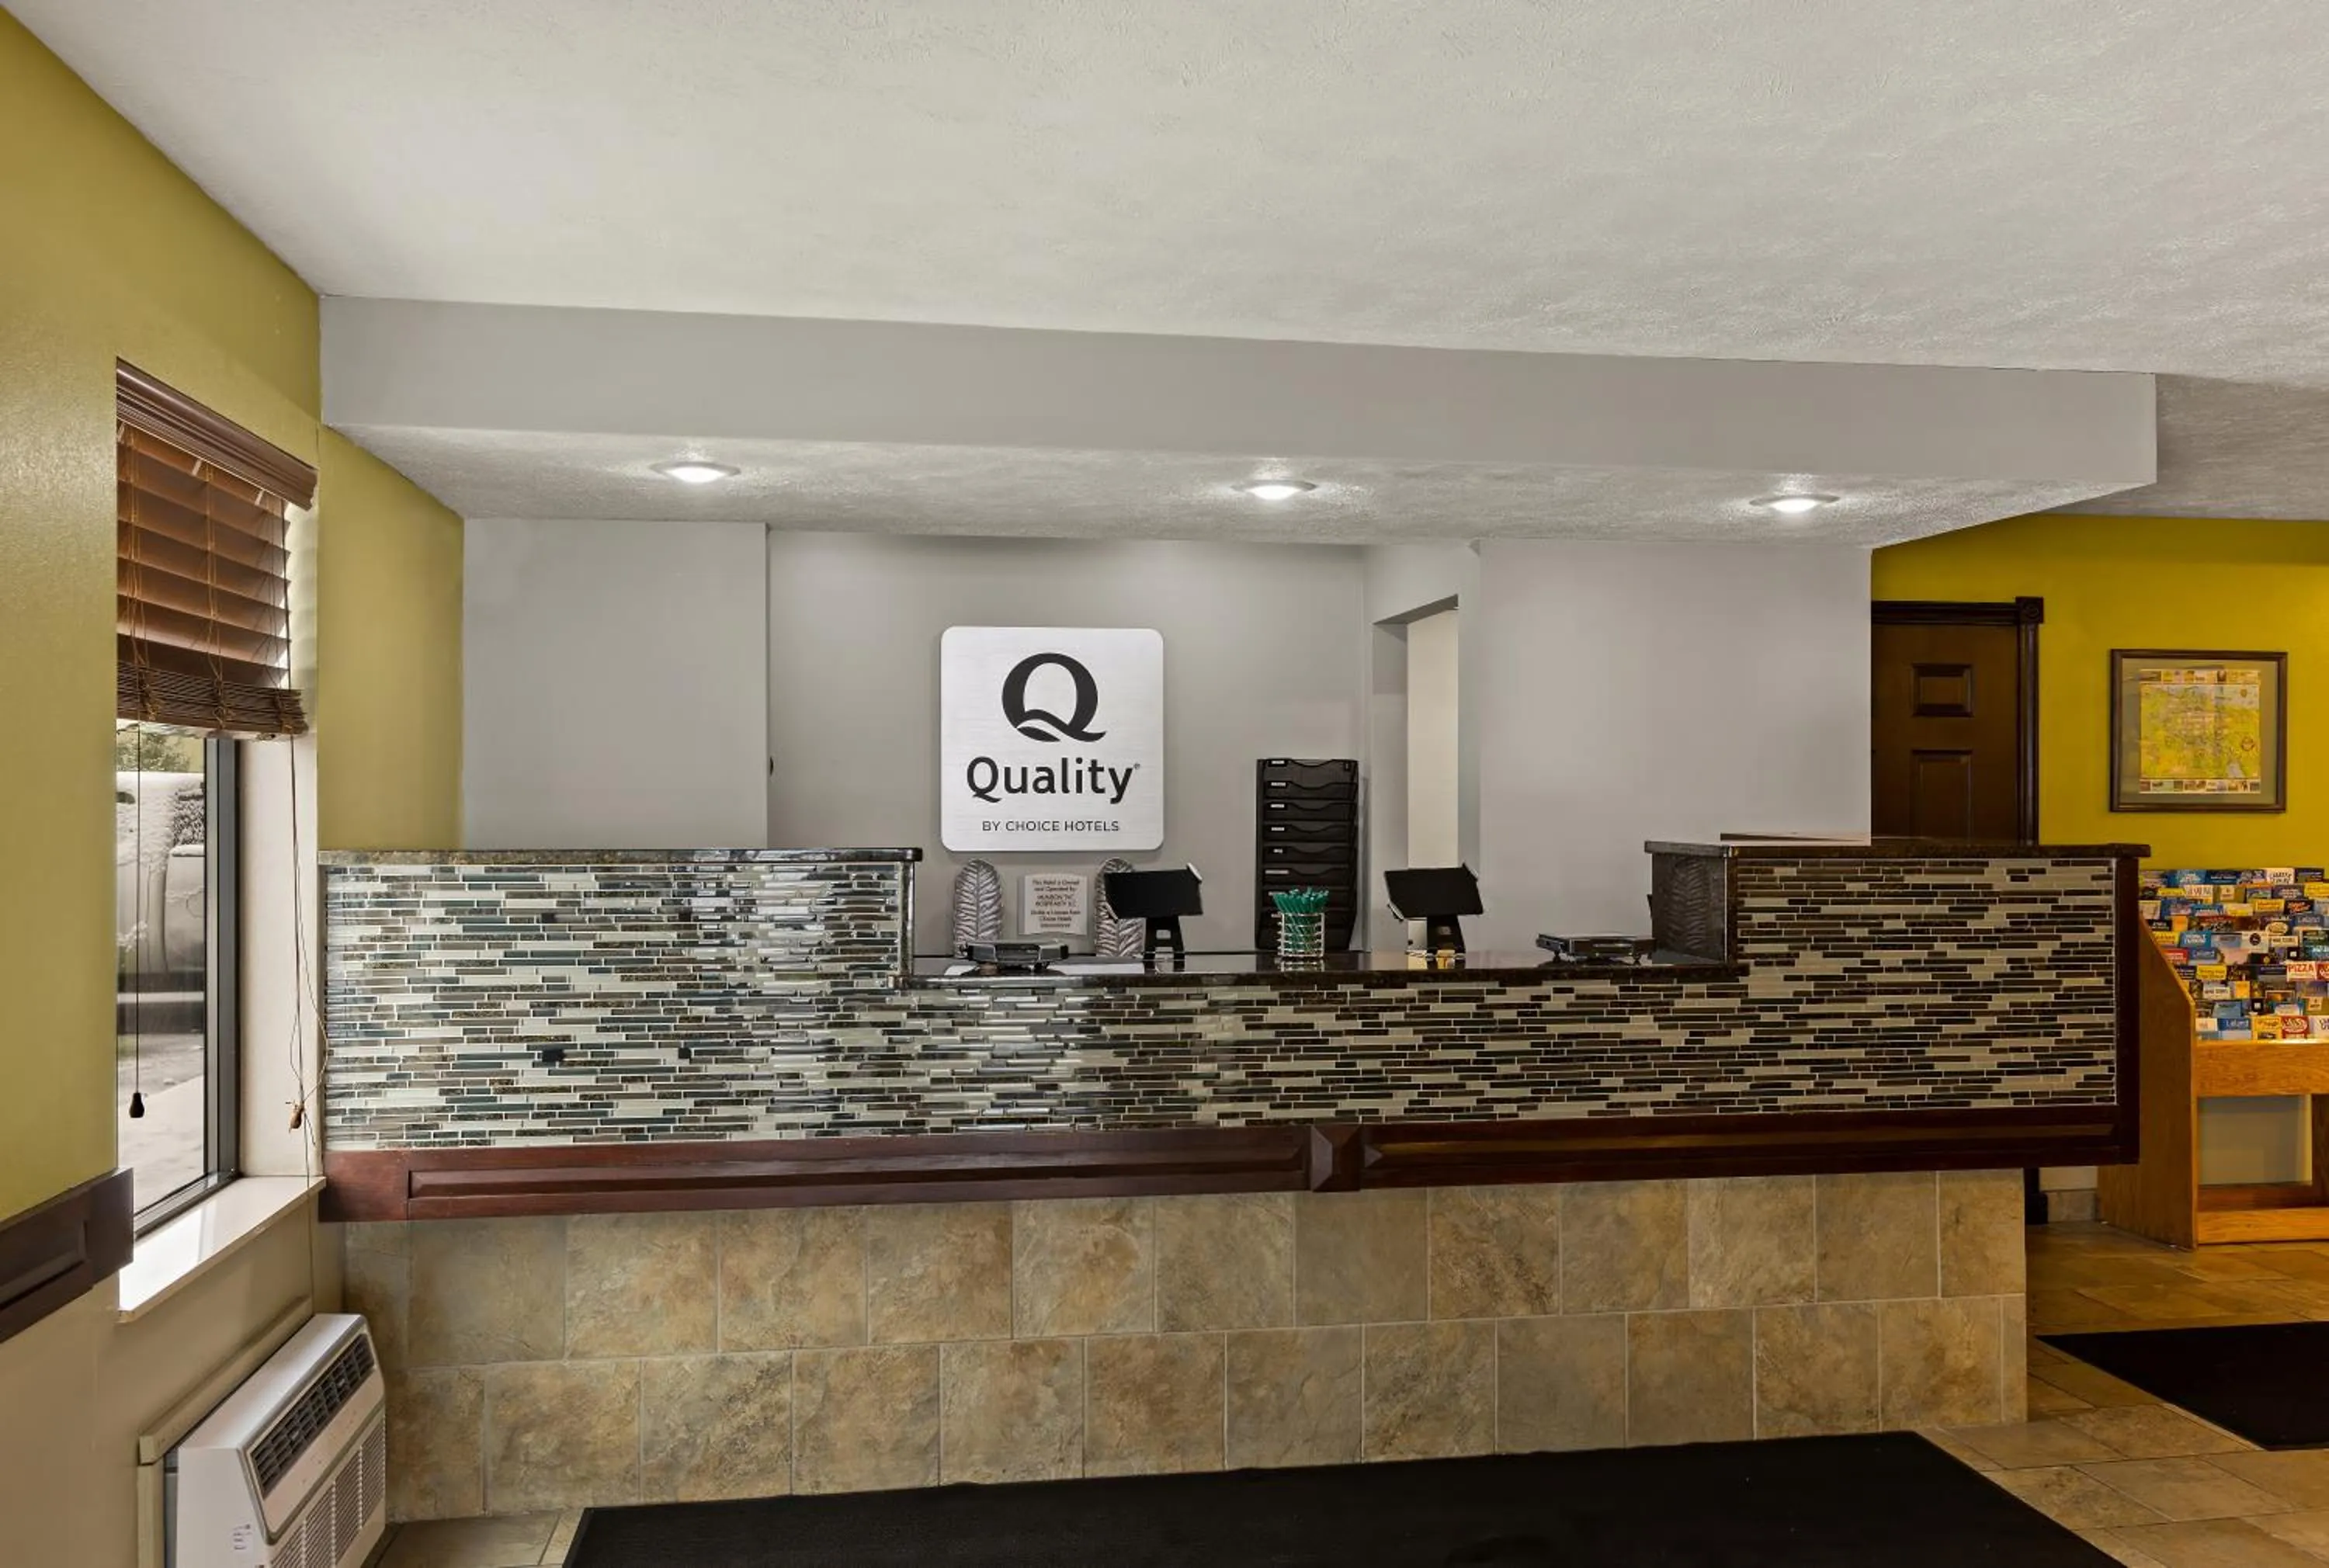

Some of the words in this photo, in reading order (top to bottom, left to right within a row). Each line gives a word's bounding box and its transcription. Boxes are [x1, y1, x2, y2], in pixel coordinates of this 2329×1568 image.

[1001, 653, 1107, 743] Q
[967, 756, 1133, 805] Quality
[982, 820, 1001, 831] BY
[1005, 820, 1060, 831] CHOICE
[1064, 820, 1119, 831] HOTELS
[2289, 963, 2314, 973] PIZZA
